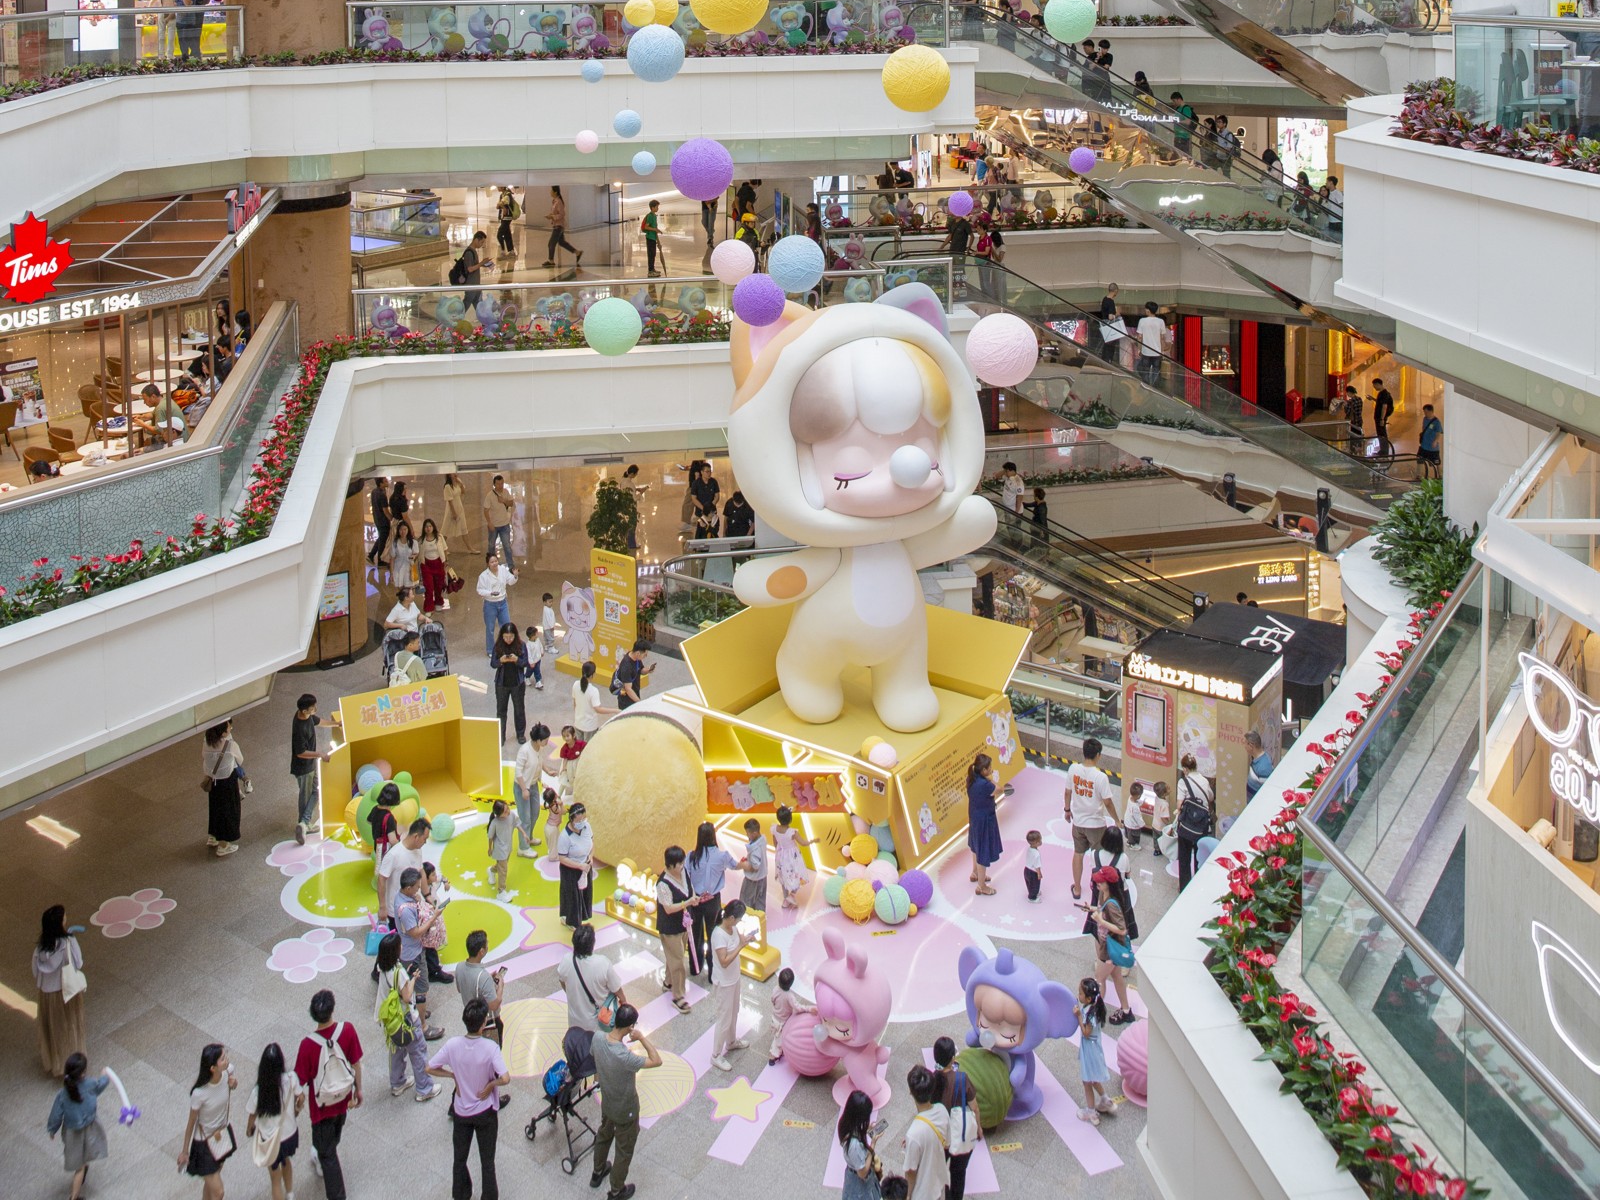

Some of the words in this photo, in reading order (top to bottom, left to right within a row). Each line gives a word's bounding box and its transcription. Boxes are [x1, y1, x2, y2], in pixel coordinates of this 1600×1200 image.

[5, 253, 58, 287] Tims
[60, 299, 99, 320] EST.
[101, 292, 141, 312] 1964
[376, 686, 428, 712] Nanci
